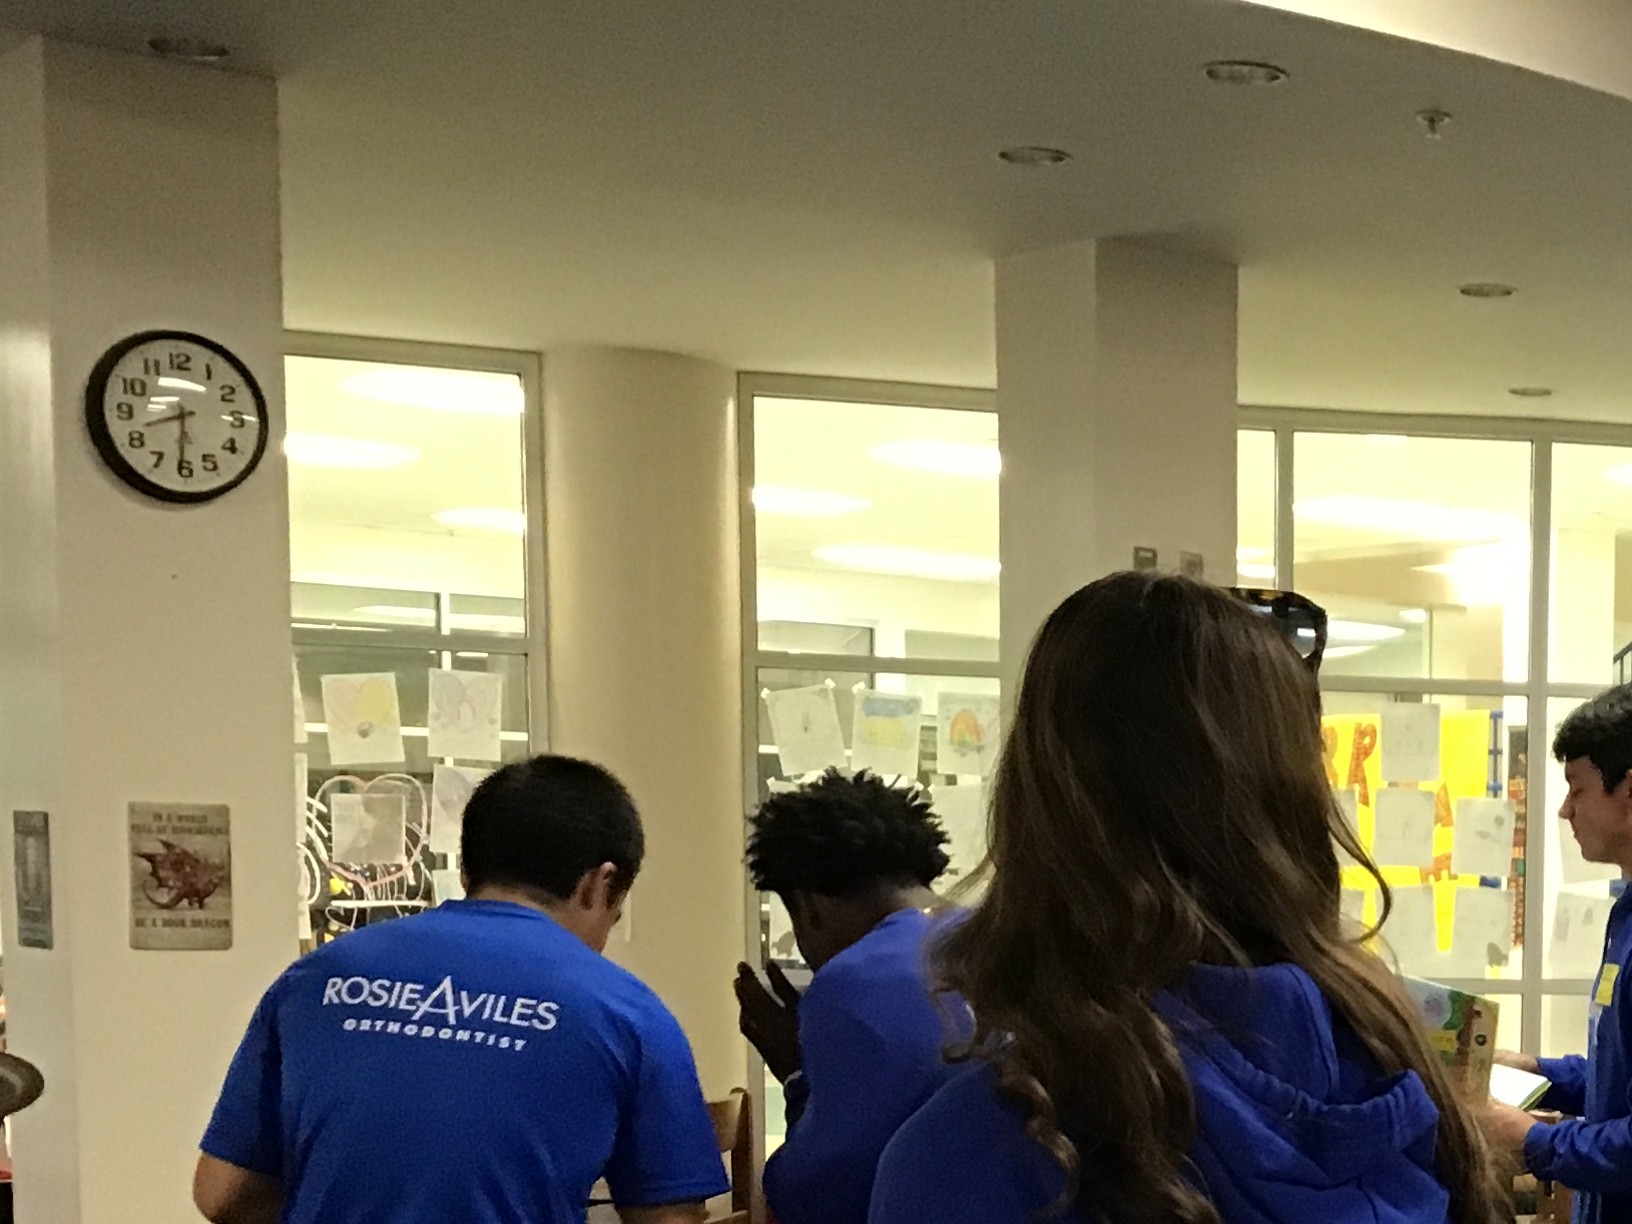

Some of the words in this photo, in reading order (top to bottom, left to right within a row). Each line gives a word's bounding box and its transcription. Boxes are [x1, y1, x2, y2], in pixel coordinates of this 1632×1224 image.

[143, 358, 161, 376] 11
[169, 352, 192, 371] 12
[205, 363, 212, 380] 1
[122, 377, 147, 397] 10
[219, 384, 236, 403] 2
[116, 402, 134, 421] 9
[128, 430, 145, 449] 8
[221, 436, 238, 454] 4
[149, 451, 165, 468] 7
[177, 460, 193, 478] 6
[201, 453, 218, 472] 5
[342, 1018, 527, 1051] ORTHODONTIST
